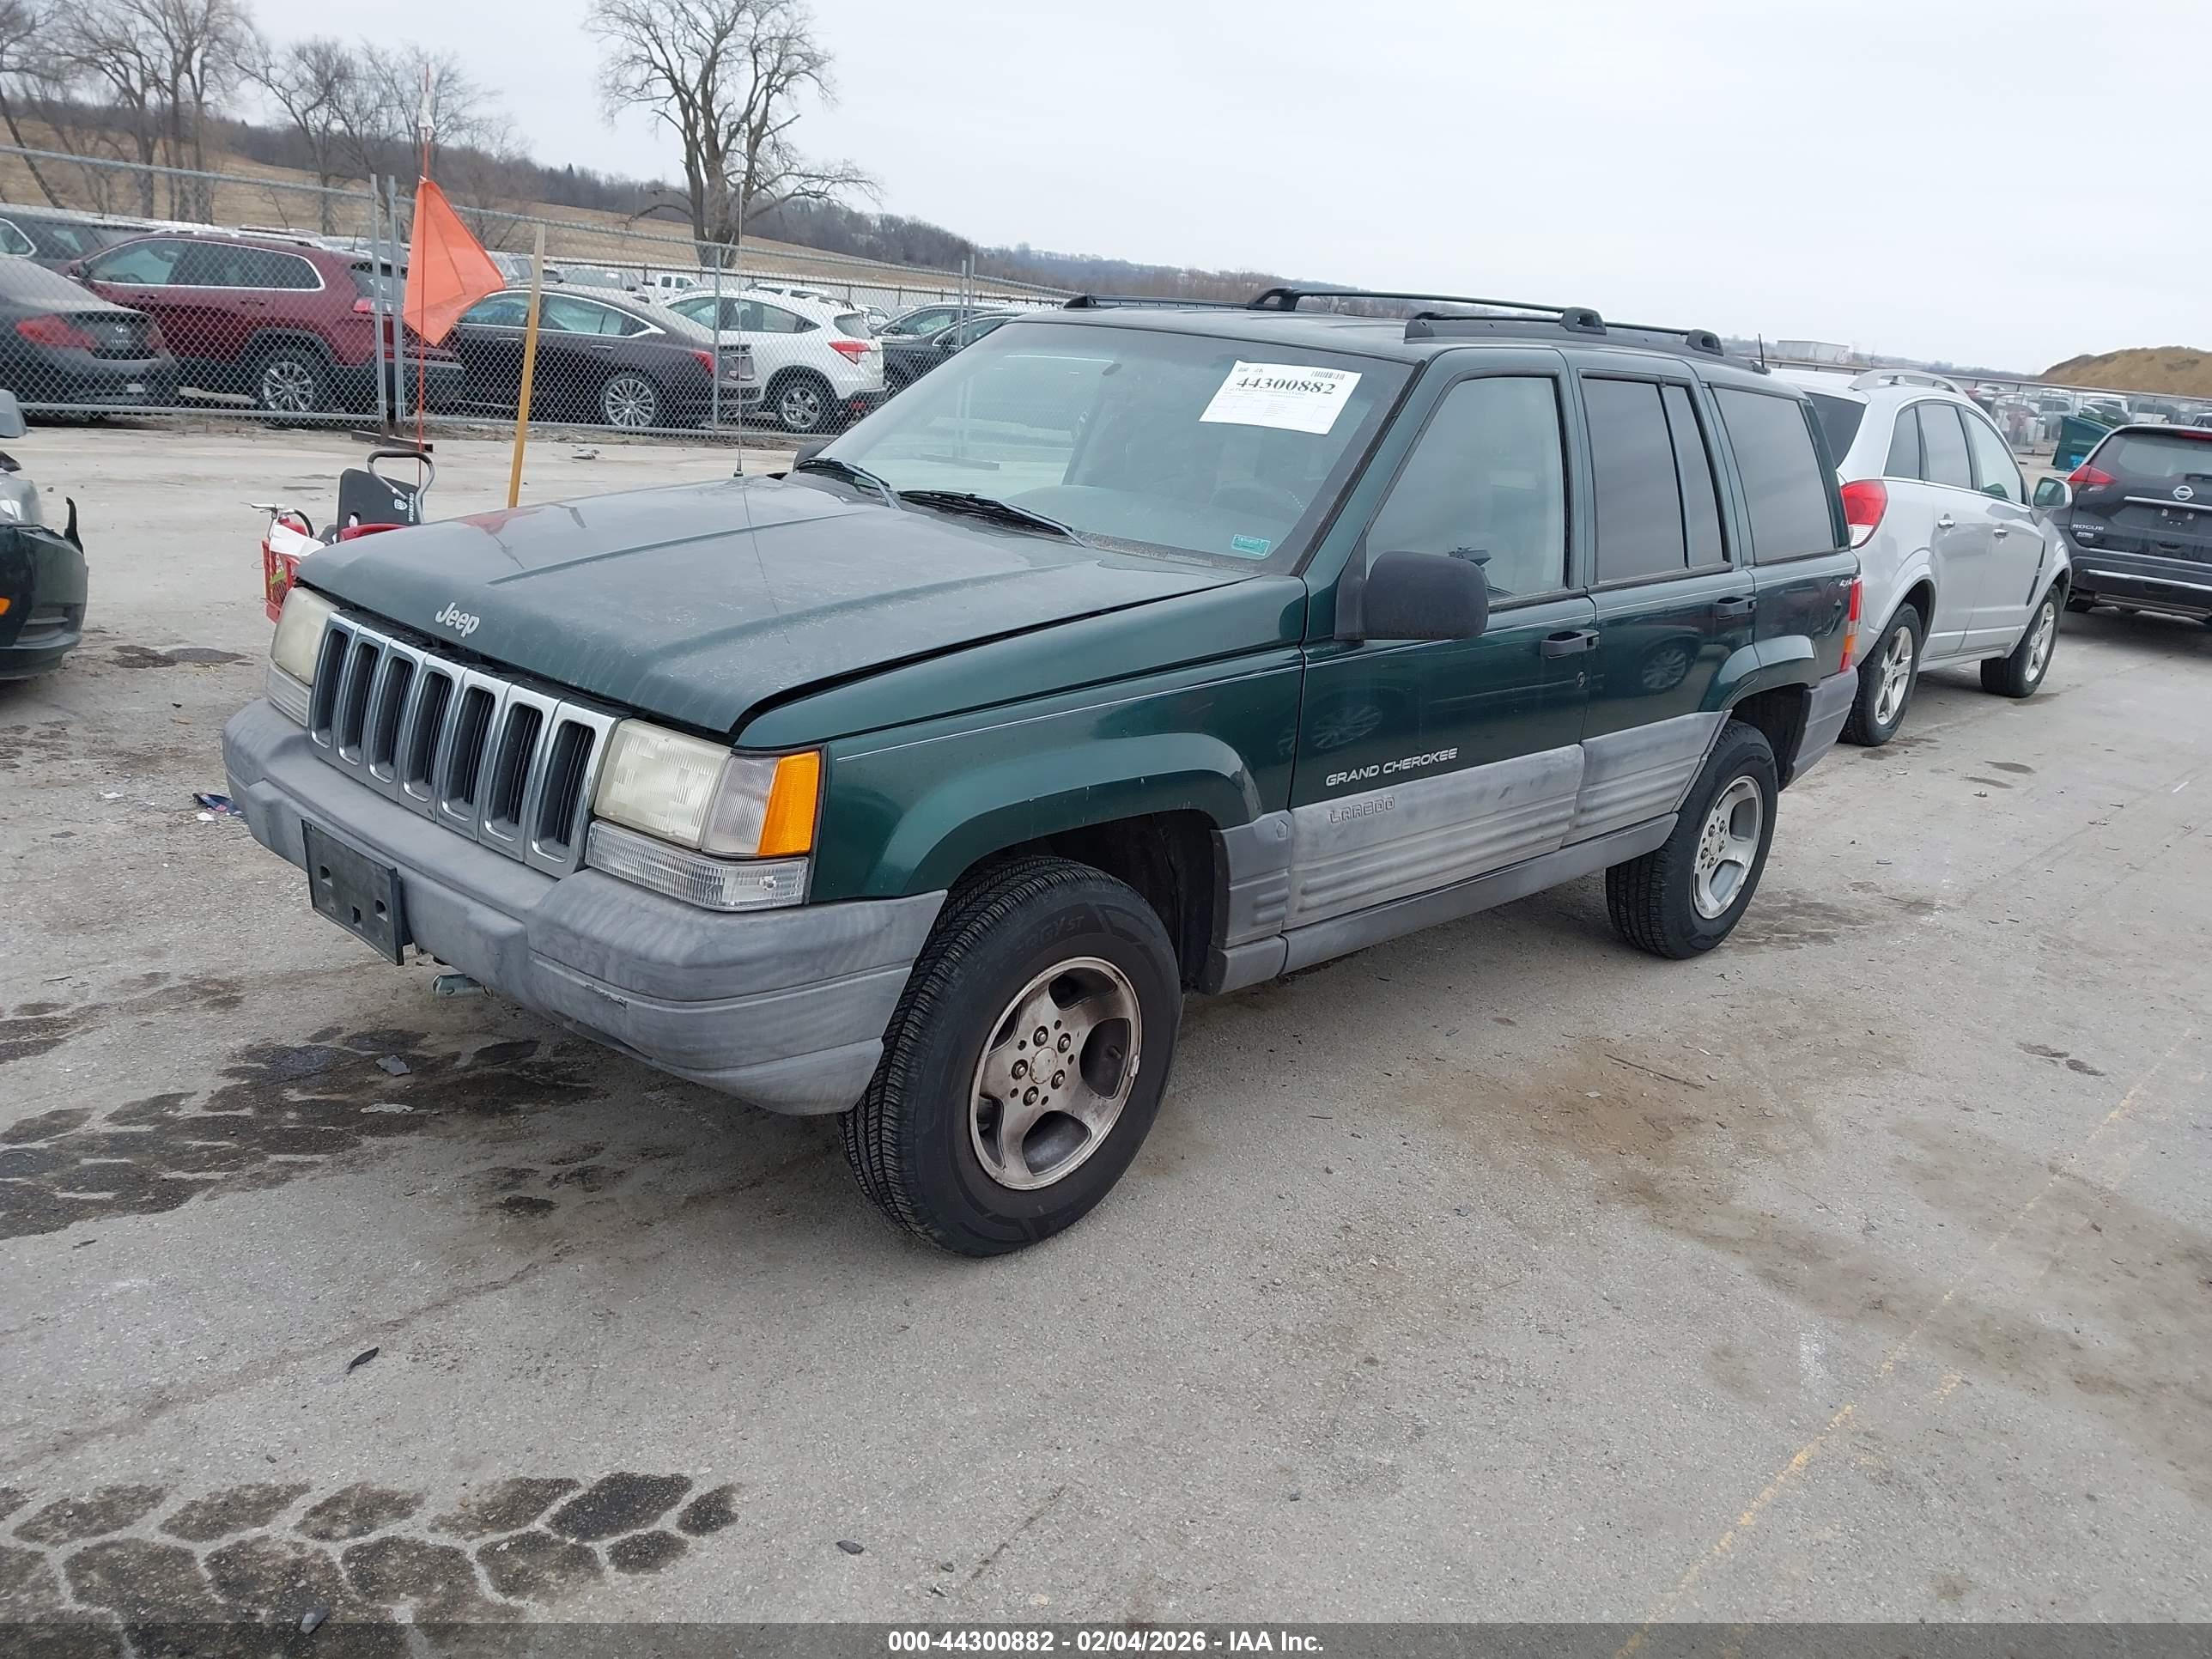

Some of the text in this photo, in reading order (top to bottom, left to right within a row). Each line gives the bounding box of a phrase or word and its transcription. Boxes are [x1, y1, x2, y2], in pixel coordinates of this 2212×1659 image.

[1237, 376, 1336, 395] 44300882
[434, 602, 480, 638] Jeep
[1325, 747, 1459, 787] GRAND CHEROKEE
[1329, 796, 1395, 823] LAREDO
